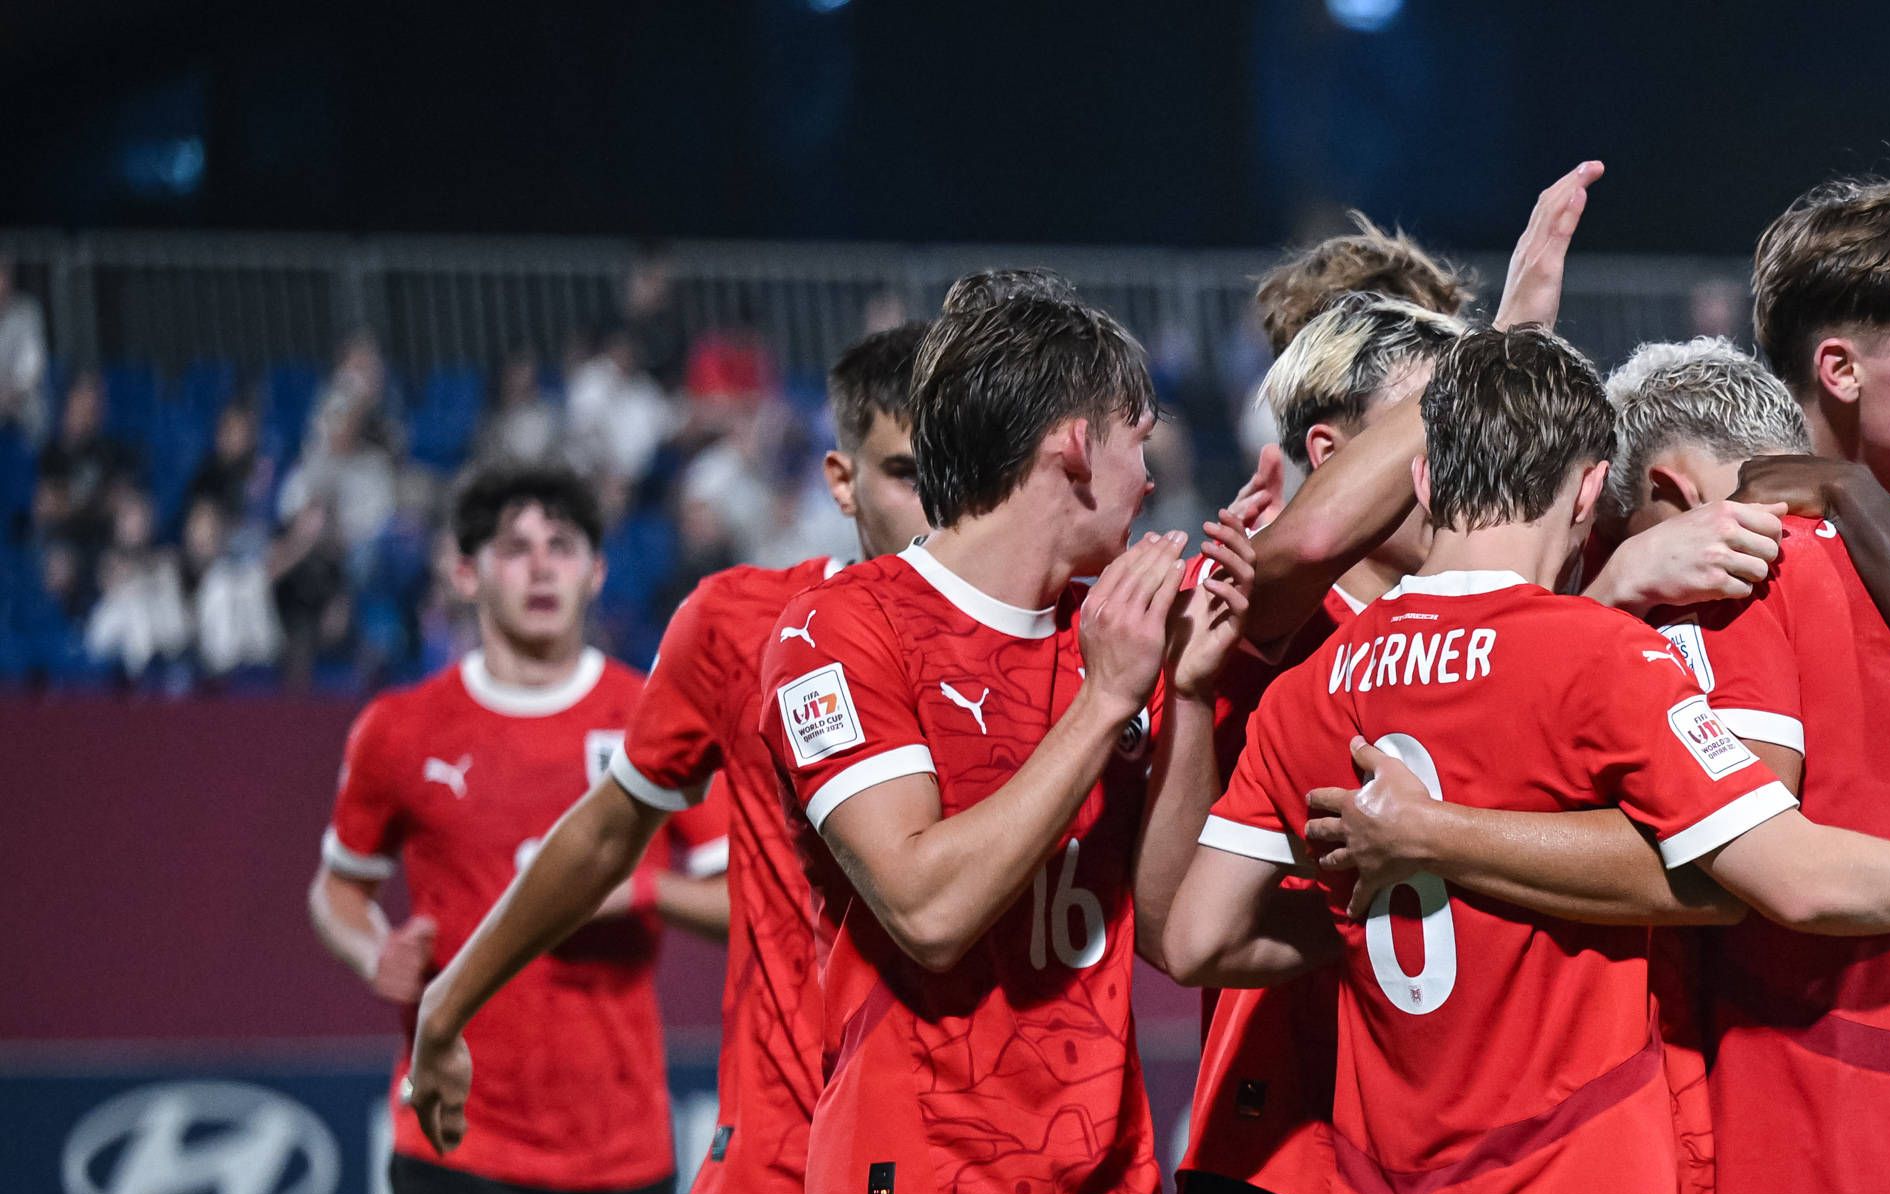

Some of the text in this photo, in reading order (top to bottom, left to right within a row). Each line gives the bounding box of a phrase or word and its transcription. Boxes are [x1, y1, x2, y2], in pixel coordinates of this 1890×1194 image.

[1328, 628, 1497, 695] WERNER
[803, 690, 820, 703] FIFA
[792, 692, 838, 726] U17
[798, 714, 844, 737] WORLD CUP
[803, 729, 825, 743] QATAR
[1702, 738, 1725, 754] WORLD
[1029, 837, 1107, 971] 16
